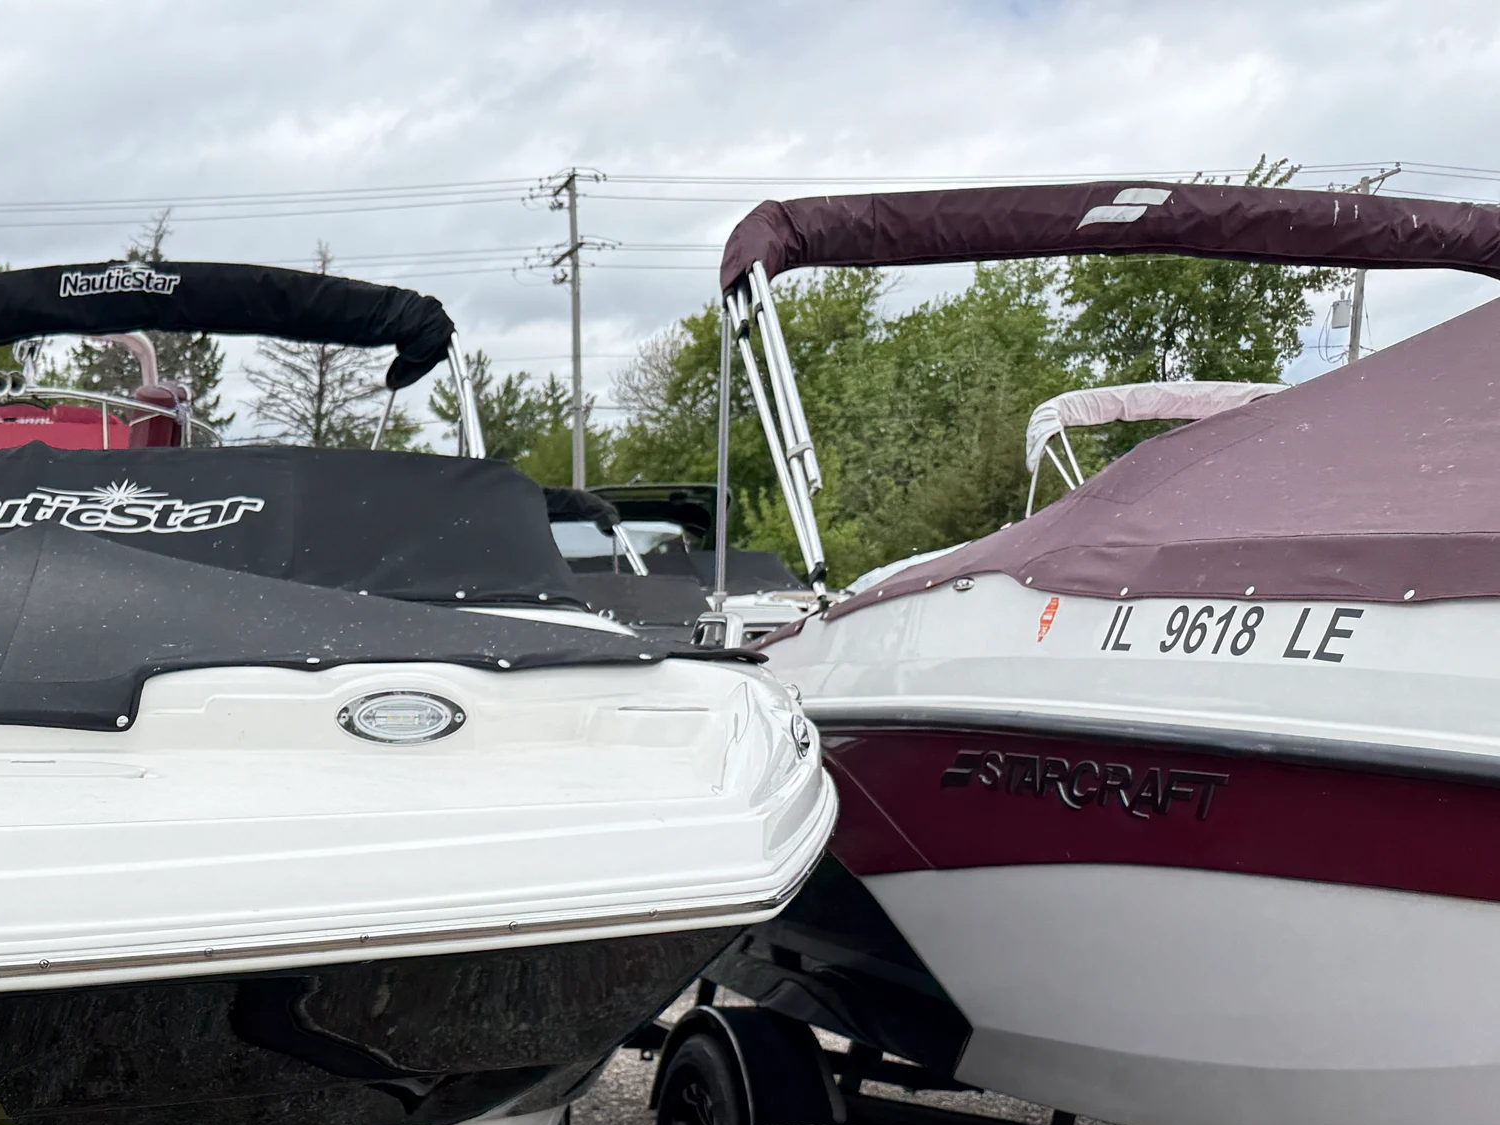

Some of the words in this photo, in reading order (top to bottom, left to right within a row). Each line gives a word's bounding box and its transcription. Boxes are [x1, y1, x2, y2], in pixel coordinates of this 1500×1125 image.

[60, 269, 181, 297] NauticStar
[1100, 605, 1134, 651] IL
[1159, 604, 1265, 657] 9618
[1282, 607, 1365, 663] LE
[977, 750, 1231, 821] STARCRAFT
